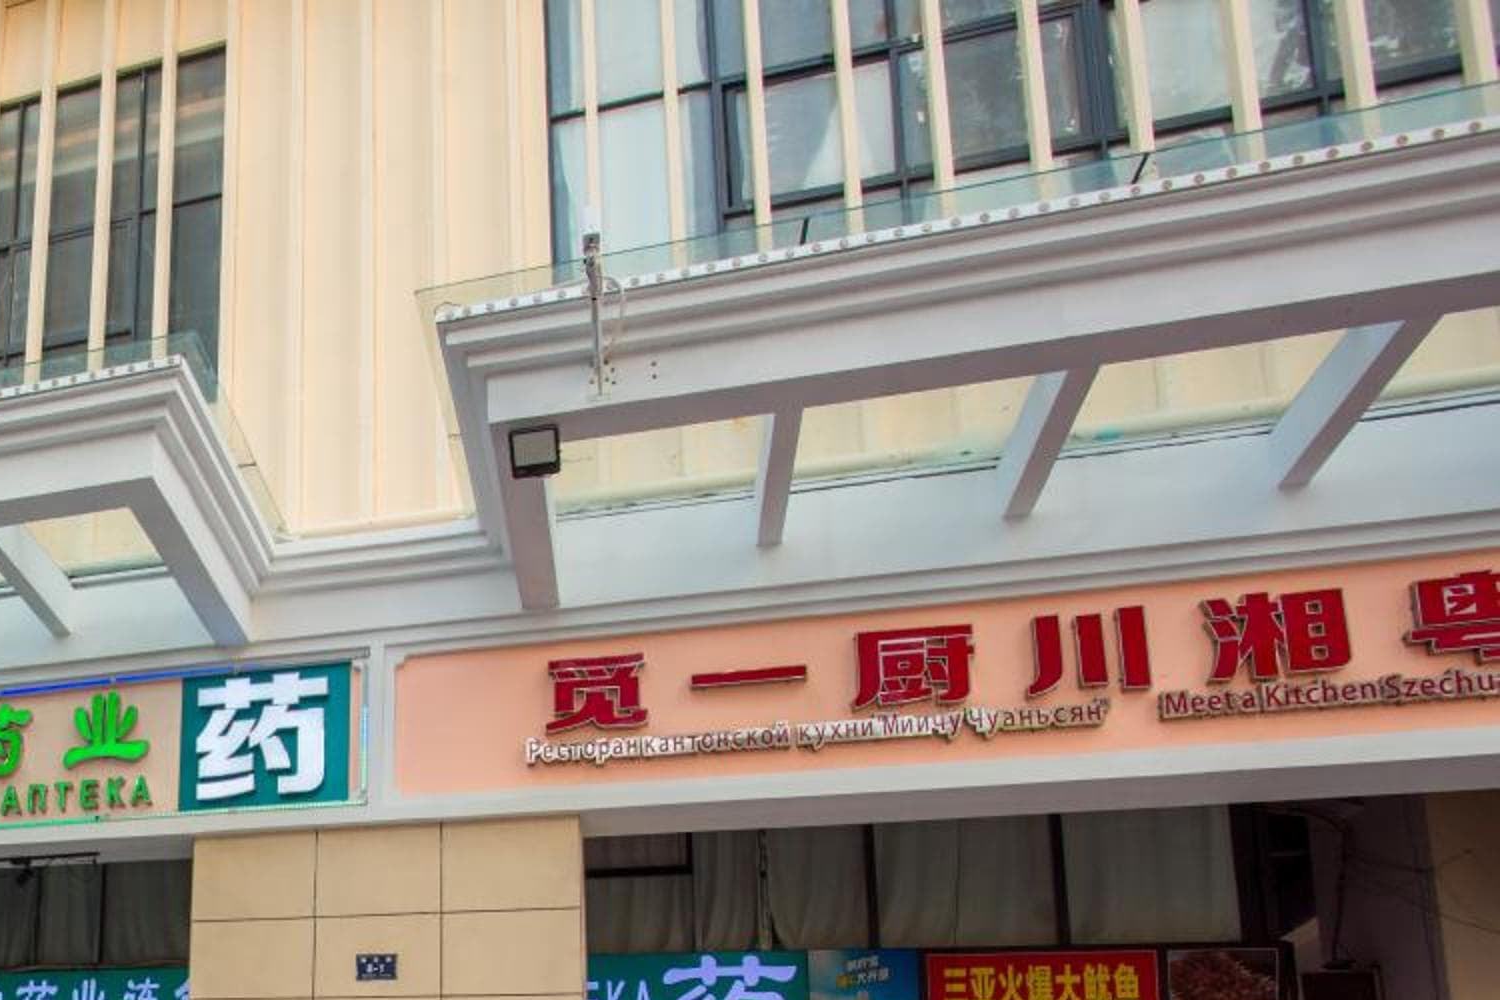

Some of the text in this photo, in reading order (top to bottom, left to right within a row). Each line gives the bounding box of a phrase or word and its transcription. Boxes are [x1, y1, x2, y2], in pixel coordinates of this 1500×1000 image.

[546, 570, 1500, 734] 觅一厨川湘粤
[1160, 670, 1500, 716] Meet a Kitchen Szechu
[196, 672, 328, 800] 药
[526, 738, 639, 765] Ресторан
[0, 774, 153, 818] АПТЕКА
